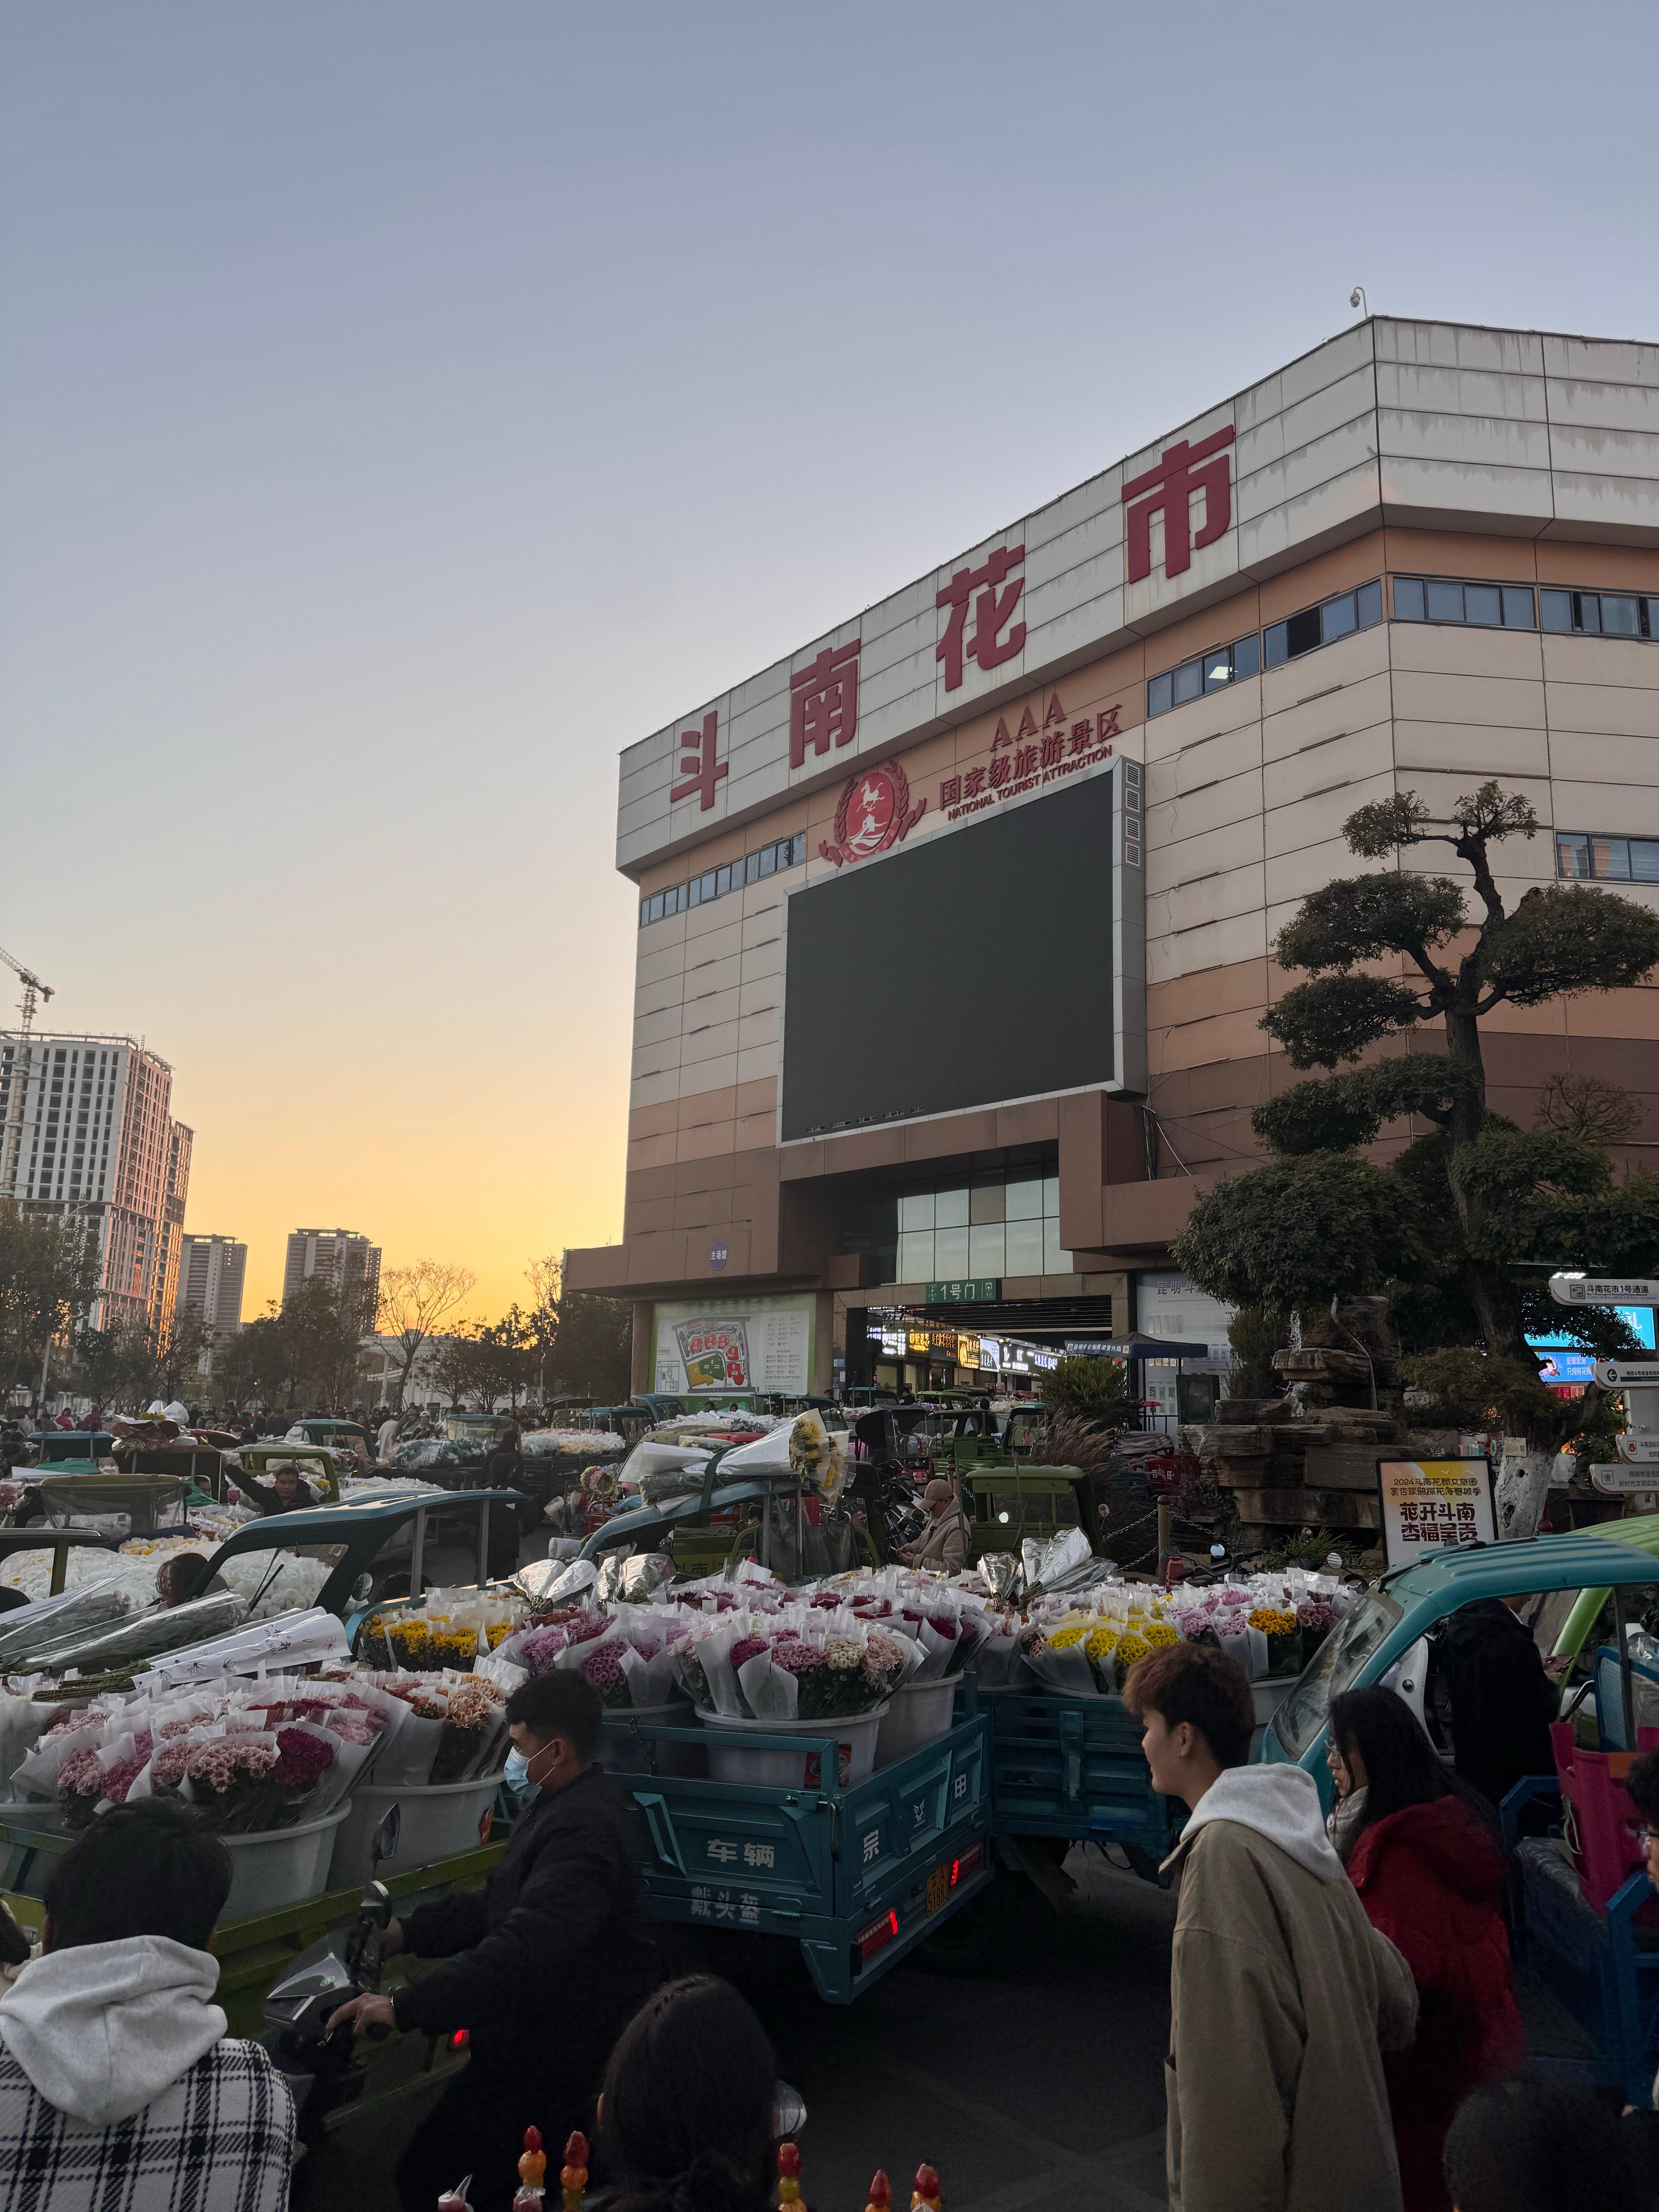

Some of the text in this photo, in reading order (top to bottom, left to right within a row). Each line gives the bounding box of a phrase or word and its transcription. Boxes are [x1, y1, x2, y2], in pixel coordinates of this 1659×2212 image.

[670, 424, 1236, 811] 斗南花市
[989, 693, 1067, 752] AAA
[939, 704, 1122, 811] 国家级旅游景区
[947, 744, 1112, 821] NATIONAL TOURIST ATTRACTION
[711, 1250, 727, 1260] 主场馆
[941, 1283, 975, 1300] 1号门
[1587, 1285, 1649, 1293] 斗南花市1号通道
[1400, 1502, 1475, 1521] 花开斗南
[1401, 1522, 1478, 1542] 杏福呈贡
[863, 1772, 967, 1863] 宗 申
[707, 1839, 775, 1868] 车辆
[691, 1886, 760, 1925] 戴头盔
